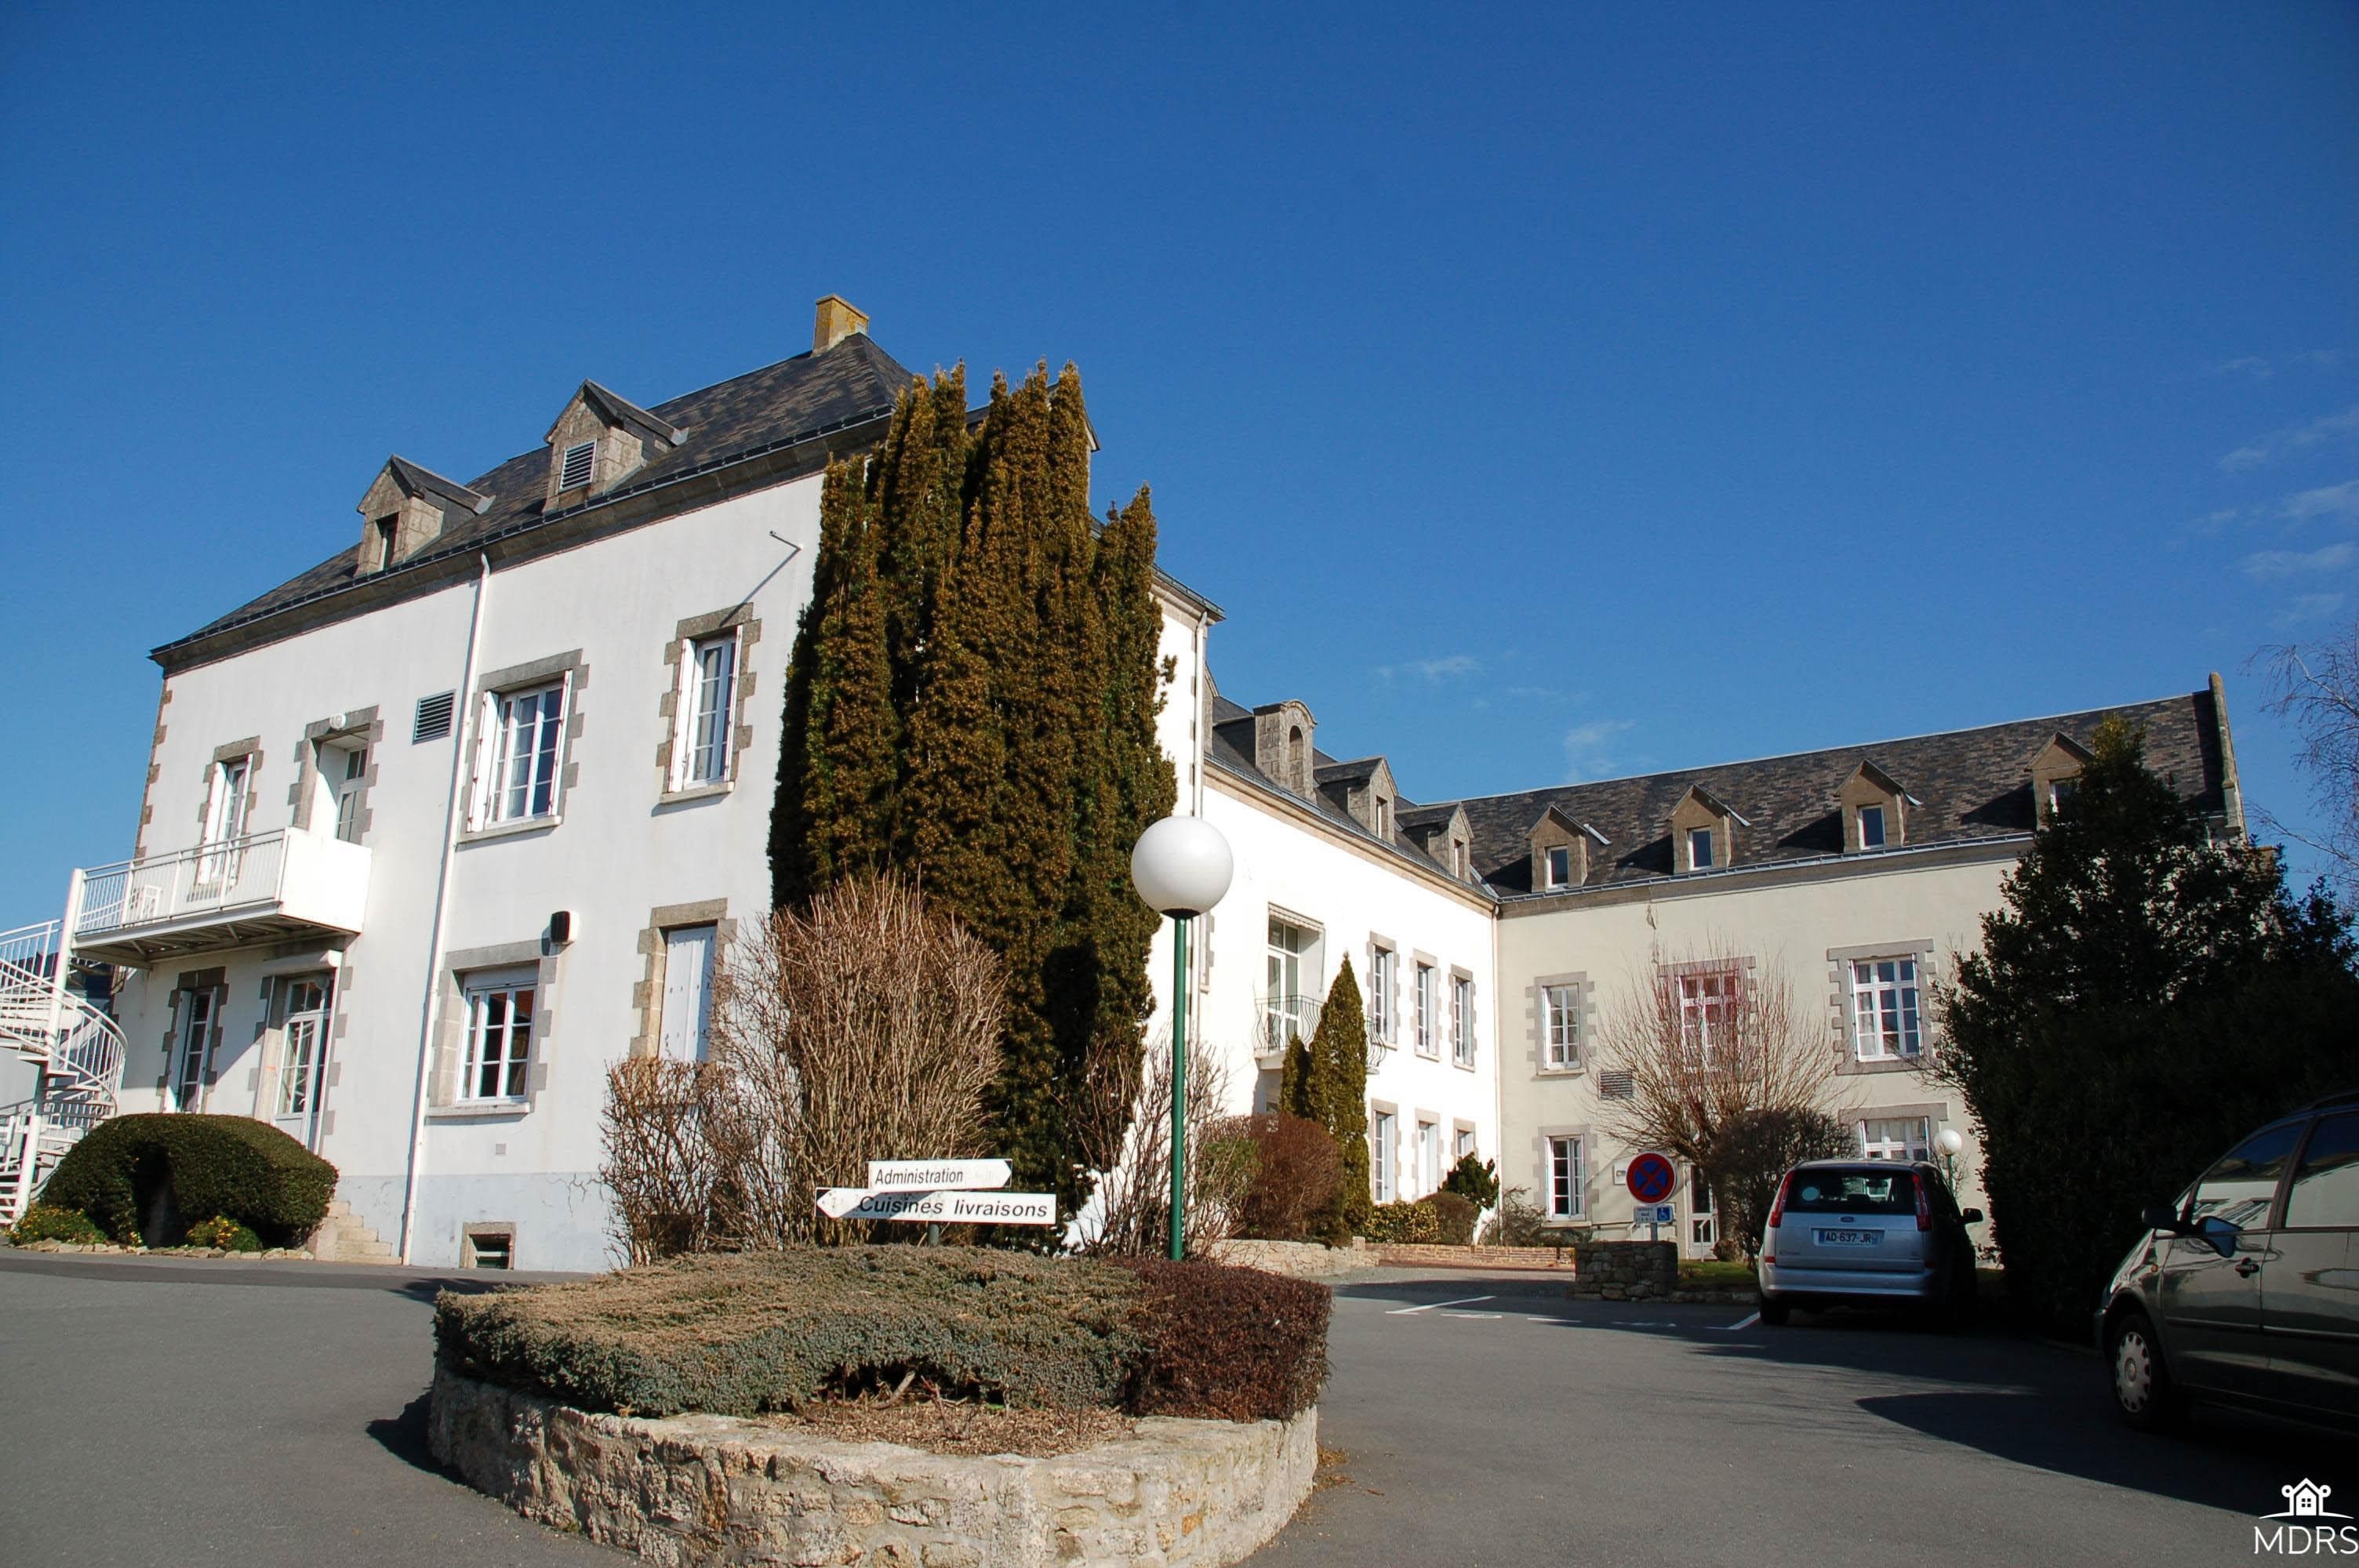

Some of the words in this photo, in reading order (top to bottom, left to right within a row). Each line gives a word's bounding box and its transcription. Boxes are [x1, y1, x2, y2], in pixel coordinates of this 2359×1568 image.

[874, 1168, 963, 1185] Administration
[860, 1196, 943, 1214] Cuisines
[954, 1199, 1048, 1218] livraisons
